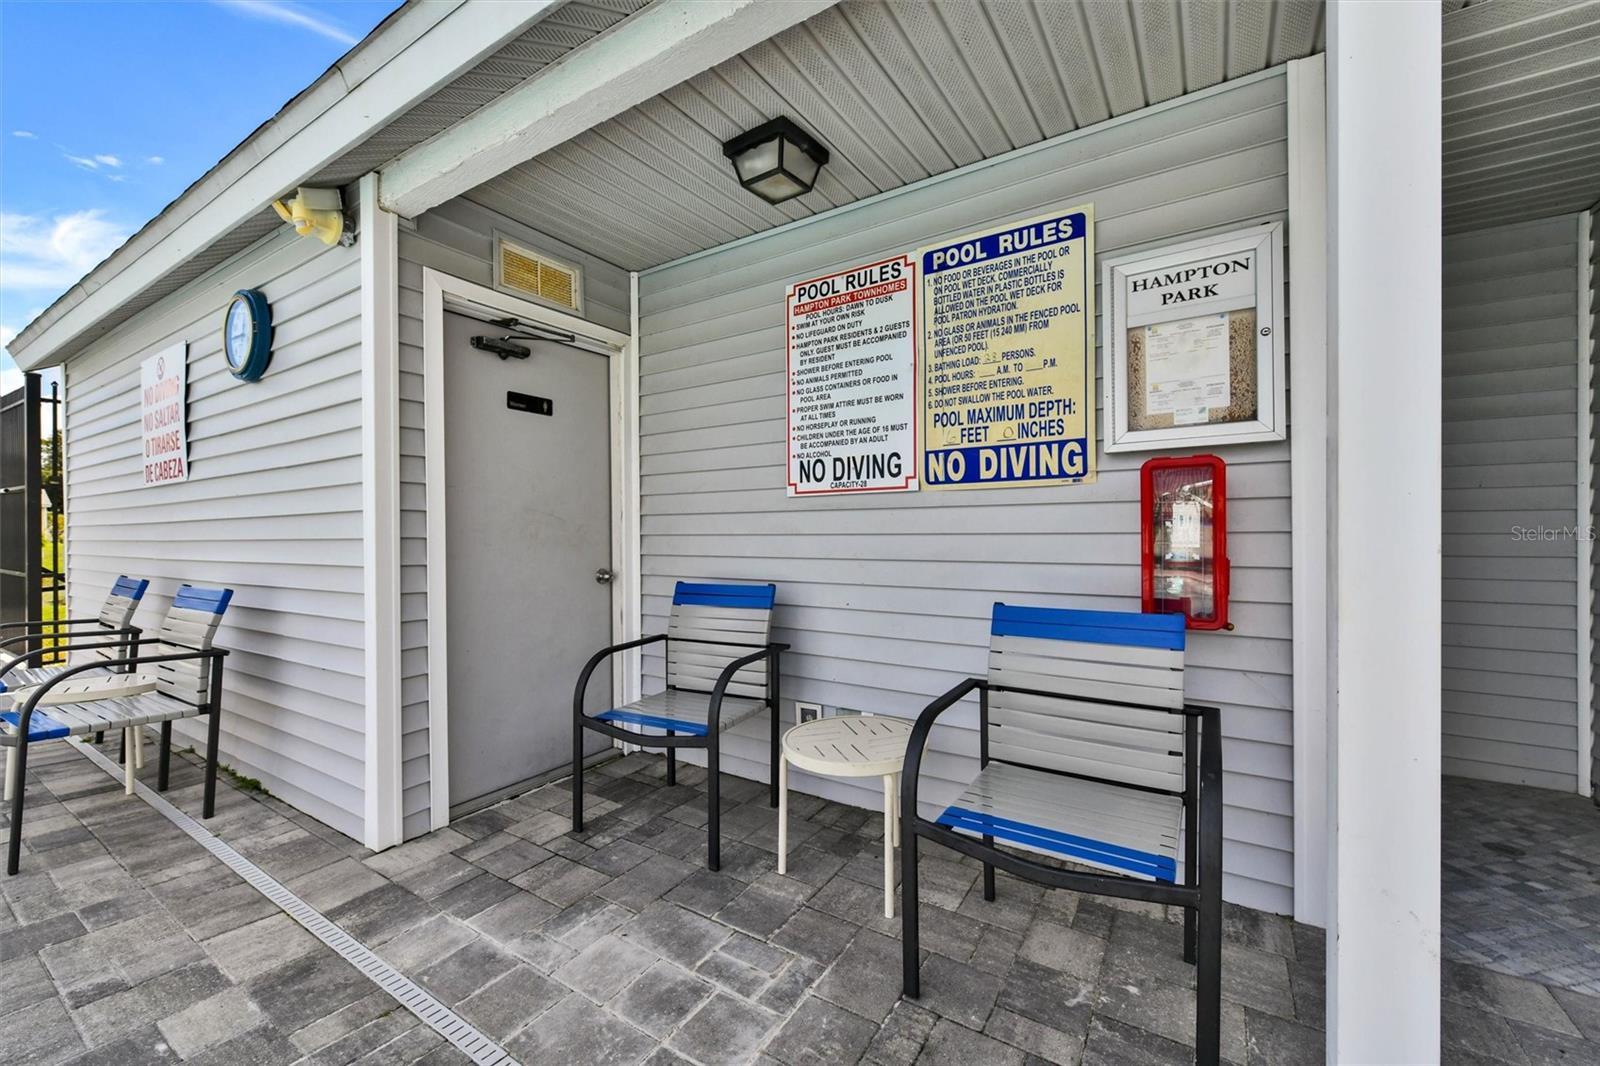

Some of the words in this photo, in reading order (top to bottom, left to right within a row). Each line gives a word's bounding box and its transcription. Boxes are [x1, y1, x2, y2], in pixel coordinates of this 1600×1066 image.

[933, 240, 987, 270] POOL
[999, 218, 1073, 255] RULES
[933, 276, 943, 286] NO
[944, 271, 961, 283] FOOD
[962, 269, 972, 279] OR
[974, 259, 1012, 277] BEVERAGES
[1023, 254, 1036, 266] THE
[1038, 249, 1057, 262] POOL
[1059, 246, 1070, 257] OR
[1132, 257, 1250, 293] HAMPTON
[798, 277, 840, 303] POOL
[846, 261, 901, 291] RULES
[934, 286, 942, 296] ON
[944, 282, 960, 293] POOL
[962, 279, 975, 290] WET
[998, 262, 1053, 282] COMMERCIALLY
[934, 292, 961, 305] BOTTLED
[963, 287, 985, 299] WATER
[995, 279, 1022, 293] PLASTIC
[1024, 272, 1056, 286] BOTTLES
[795, 299, 829, 315] HAMPTON
[831, 294, 852, 306] PARK
[854, 280, 905, 300] TOWNHOMES
[934, 302, 964, 315] ALLOWED
[965, 299, 974, 309] ON
[976, 297, 988, 307] THE
[990, 292, 1008, 304] POOL
[1010, 289, 1024, 300] WET
[1026, 285, 1046, 297] DECK
[1048, 281, 1062, 293] FOR
[1161, 283, 1219, 306] PARK
[797, 322, 810, 330] SWIM
[820, 316, 835, 325] YOUR
[837, 313, 849, 321] OWN
[851, 309, 865, 318] RISK
[806, 312, 821, 320] POOL
[846, 302, 864, 311] DAWN
[866, 299, 874, 307] TO
[876, 295, 893, 304] DUSK
[934, 314, 950, 325] POOL
[952, 309, 977, 322] PATRON
[806, 326, 836, 338] LIFEGUARD
[847, 320, 862, 329] DUTY
[934, 329, 942, 338] NO
[944, 325, 964, 336] GLASS
[966, 323, 975, 332] OR
[976, 317, 1005, 330] ANIMALS
[1007, 315, 1014, 325] IN
[1015, 313, 1028, 323] THE
[1031, 307, 1058, 320] FENCED
[1061, 303, 1080, 315] POOL
[797, 339, 822, 349] HAMPTON
[824, 336, 838, 344] PARK
[840, 329, 872, 341] RESIDENTS
[885, 321, 910, 332] GUESTS
[816, 345, 834, 355] GUEST
[836, 342, 851, 351] MUST
[862, 331, 907, 346] ACCOMPANIED
[935, 337, 950, 348] AREA
[953, 334, 963, 345] (OR
[964, 333, 971, 343] 50
[973, 330, 988, 341] FEET
[991, 328, 1000, 338] (15
[1001, 326, 1012, 337] 240
[1014, 323, 1027, 334] MM)
[1029, 319, 1049, 332] FROM
[809, 354, 835, 364] RESIDENT
[934, 345, 966, 359] UNFENCED
[935, 360, 960, 371] BATHING
[1002, 348, 1036, 361] PERSONS.
[797, 367, 820, 376] SHOWER
[821, 362, 843, 372] BEFORE
[845, 357, 874, 368] ENTERING
[876, 354, 893, 362] POOL
[806, 375, 829, 384] ANIMALS
[831, 369, 863, 380] PERMITTED
[935, 374, 950, 383] POOL
[952, 370, 975, 381] HOURS:
[1014, 363, 1023, 372] TO
[1043, 358, 1057, 368] P.M.
[144, 387, 153, 408] NO
[154, 375, 180, 402] DIVING
[806, 386, 823, 394] GLASS
[825, 380, 861, 391] CONTAINERS
[873, 375, 890, 384] FOOD
[816, 393, 831, 401] AREA
[935, 385, 960, 396] SHOWER
[962, 381, 987, 393] BEFORE
[989, 376, 1024, 389] ENTERING.
[935, 399, 943, 408] DO
[945, 398, 956, 407] NOT
[958, 393, 990, 405] SWALLOW
[992, 392, 1005, 401] THE
[1007, 389, 1025, 400] POOL
[1027, 385, 1054, 397] WATER.
[797, 405, 818, 413] PROPER
[836, 400, 855, 408] ATTIRE
[884, 393, 904, 402] WORN
[934, 411, 964, 428] POOL
[967, 404, 1024, 425] MAXIMUM
[1029, 398, 1076, 419] DEPTH:
[144, 412, 153, 433] NO
[154, 402, 181, 430] SALTAR
[806, 421, 838, 430] HORSEPLAY
[850, 417, 876, 425] RUNNING
[145, 440, 150, 458] O
[151, 430, 181, 457] TIRARSE
[797, 433, 823, 441] CHILDREN
[825, 430, 845, 438] UNDER
[809, 439, 849, 448] ACCOMPANIED
[869, 435, 888, 443] ADULT
[961, 426, 989, 444] FEET
[1018, 419, 1064, 439] INCHES
[145, 464, 154, 484] DE
[154, 457, 184, 482] CABEZA
[800, 458, 826, 483] NO
[833, 452, 902, 481] DIVING
[928, 450, 966, 482] NO
[980, 441, 1083, 480] DIVING
